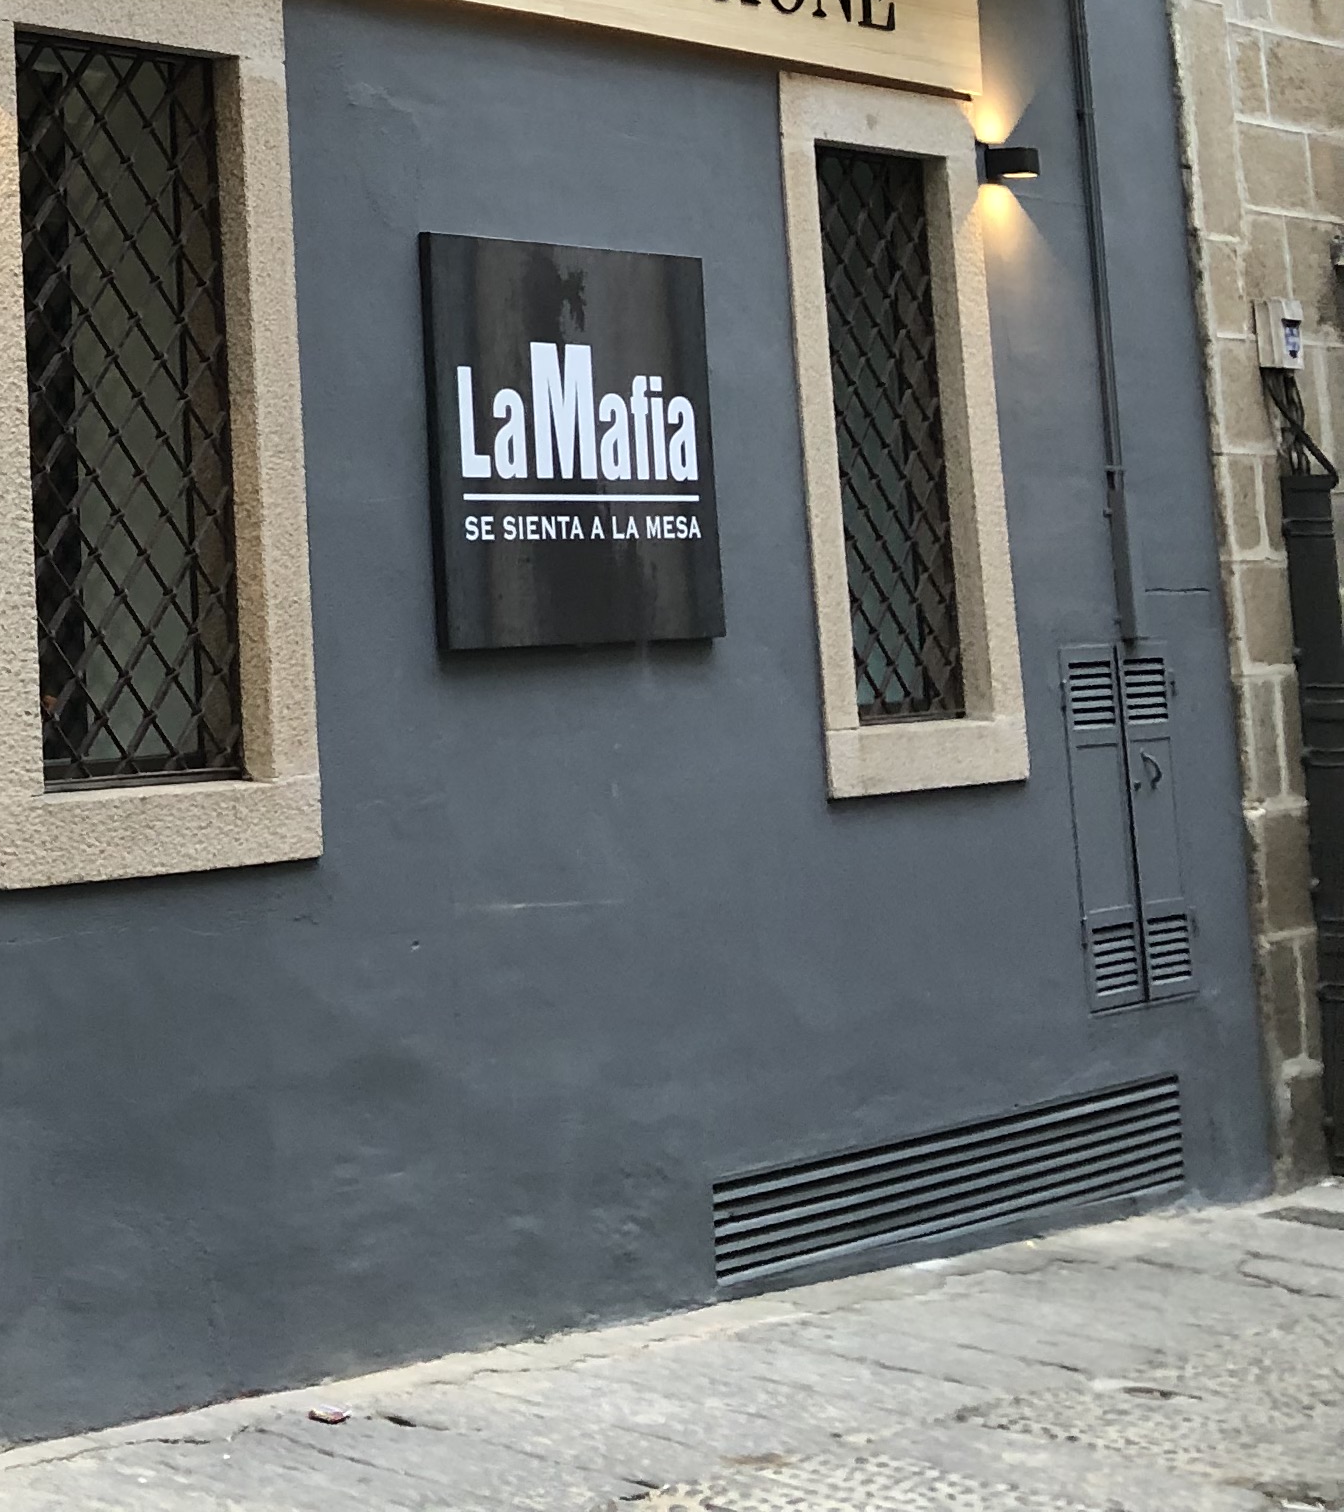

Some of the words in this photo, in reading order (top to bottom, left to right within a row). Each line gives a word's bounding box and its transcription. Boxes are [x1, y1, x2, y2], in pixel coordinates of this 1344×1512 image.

[464, 515, 495, 541] SE
[502, 515, 585, 540] SIENTA
[590, 515, 605, 540] A
[611, 515, 640, 540] LA
[646, 515, 702, 540] MESA
